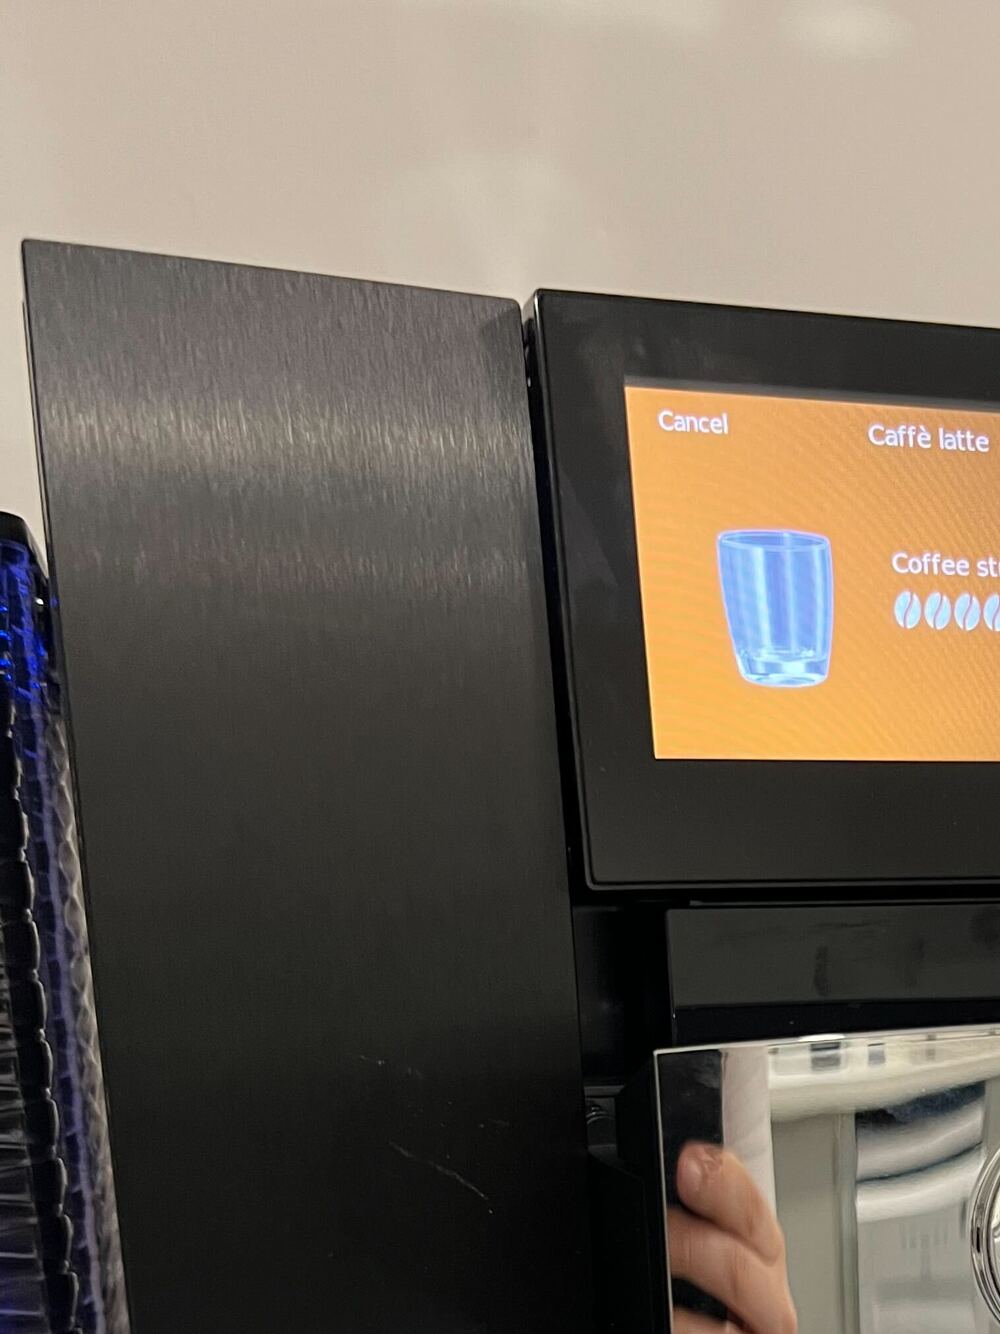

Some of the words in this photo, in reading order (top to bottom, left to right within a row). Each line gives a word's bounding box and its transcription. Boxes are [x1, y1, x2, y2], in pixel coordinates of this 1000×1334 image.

[658, 411, 729, 435] Cancel
[868, 425, 931, 449] Caffè
[938, 428, 990, 453] latte
[892, 553, 970, 577] Coffee
